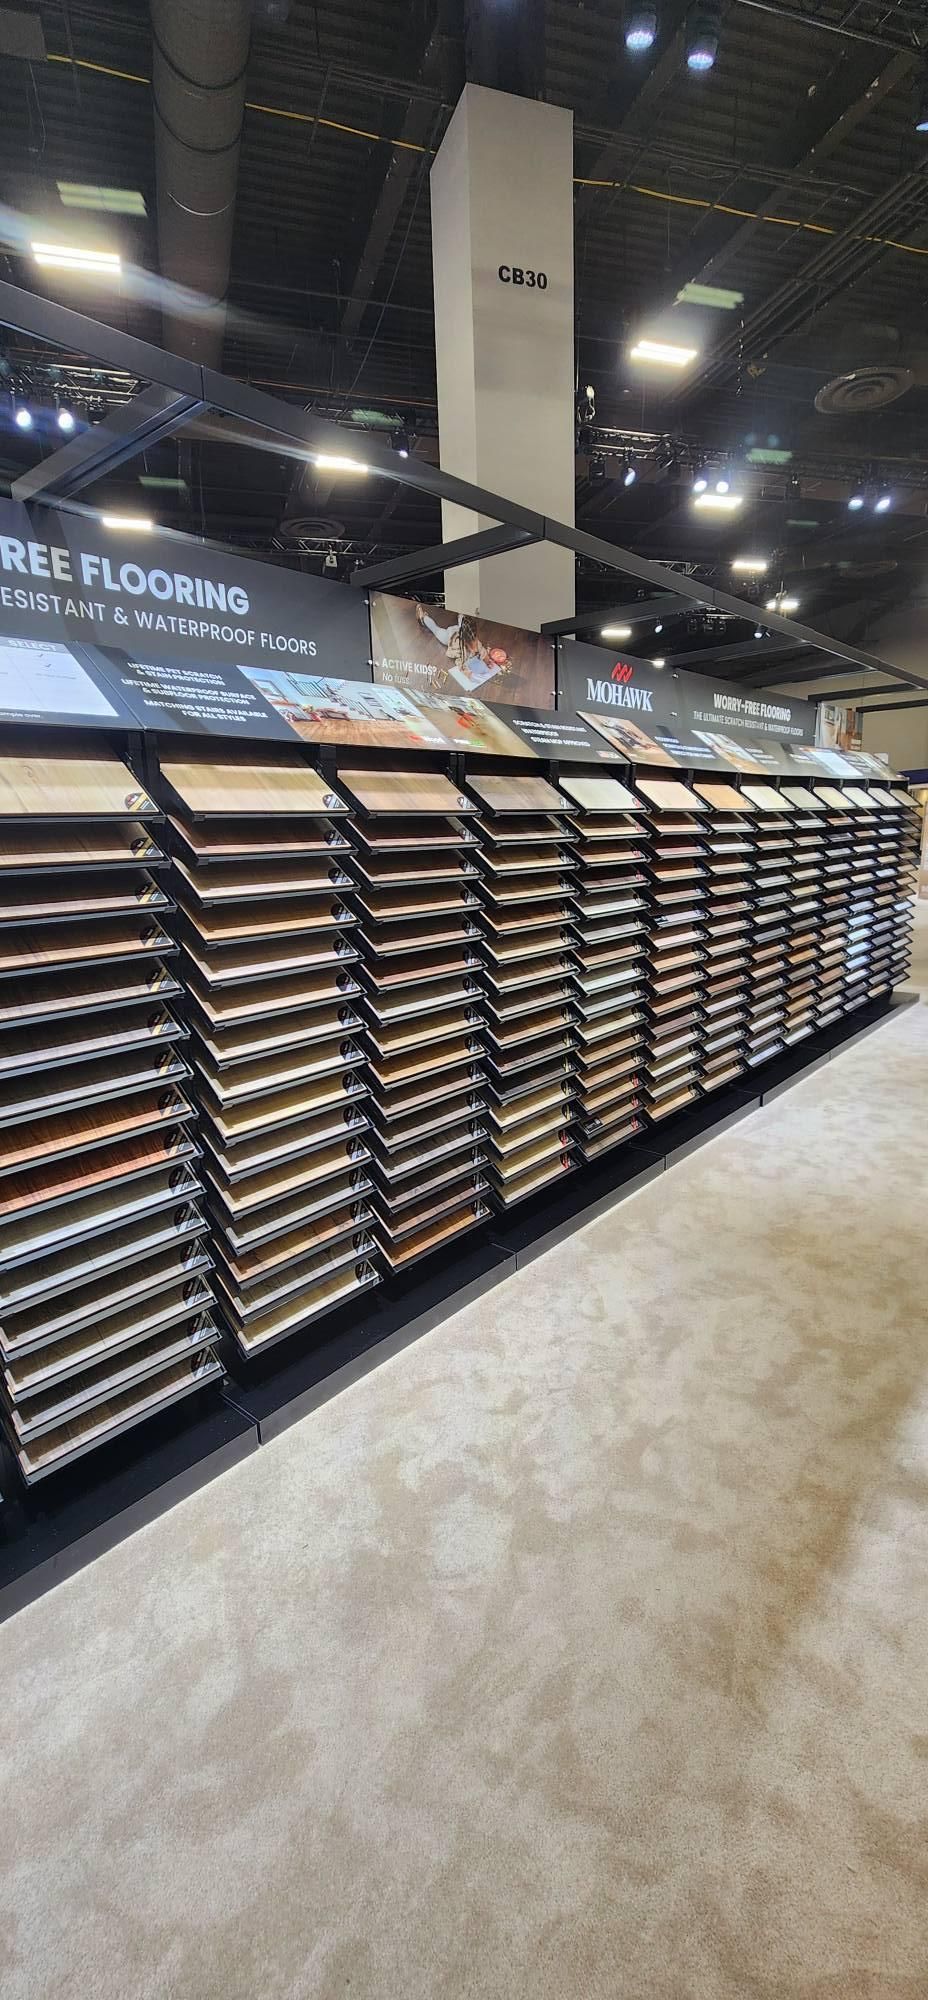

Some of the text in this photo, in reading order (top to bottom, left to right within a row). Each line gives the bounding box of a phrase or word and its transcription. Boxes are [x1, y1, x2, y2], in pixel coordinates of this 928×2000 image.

[498, 265, 547, 290] CB30
[0, 535, 250, 615] REE FLOORING
[0, 586, 318, 657] ESISTANT & WATERPROOF FLOORS
[8, 639, 57, 652] SELECT
[127, 662, 223, 681] LIFETIME PET SCRATCH
[382, 658, 437, 676] ACTIVE KIDS?
[145, 670, 173, 680] STAIN
[172, 674, 226, 686] PROTECTION
[121, 678, 257, 701] LIFETIME WATERPROOF SURFACE
[151, 688, 198, 700] SUBFLOOR
[198, 693, 251, 705] PROTECTION
[586, 677, 654, 712] MOHAWK
[144, 700, 269, 718] MATCHING STAIRS AVAILABLE
[181, 710, 247, 722] FOR ALL STYLES
[713, 693, 792, 721] WORRY-FREE FLOORING
[693, 711, 703, 721] THE
[703, 713, 725, 724] ULTIMATE
[724, 715, 745, 727] SCRATCH
